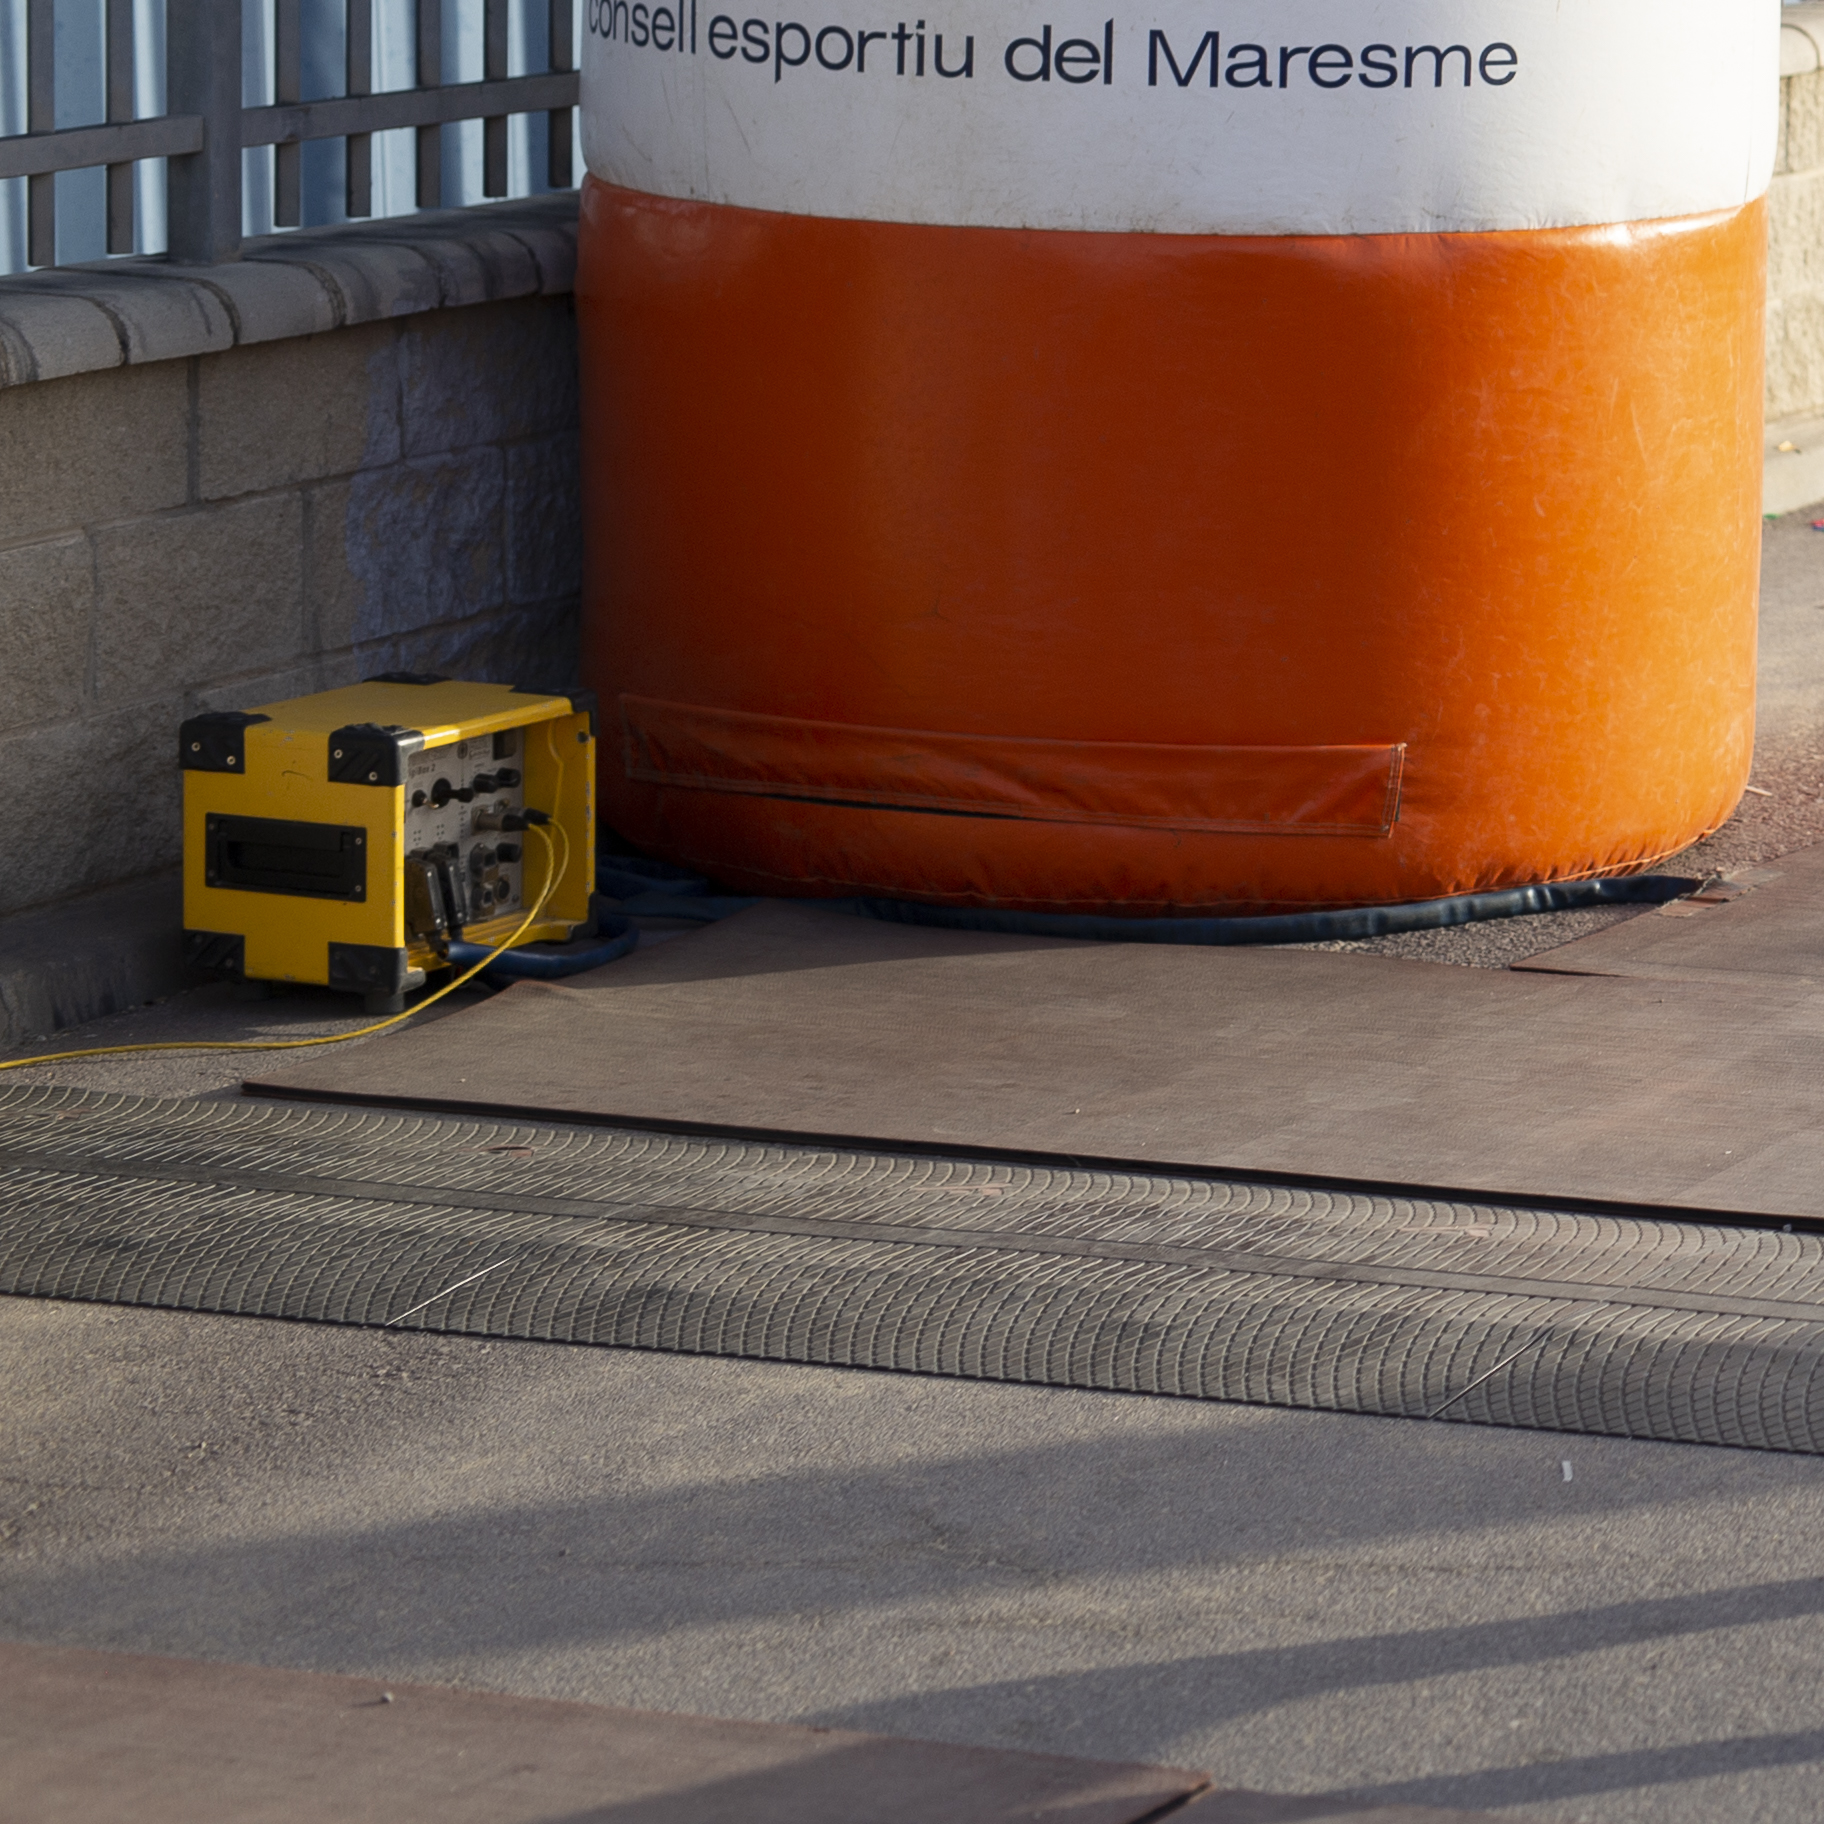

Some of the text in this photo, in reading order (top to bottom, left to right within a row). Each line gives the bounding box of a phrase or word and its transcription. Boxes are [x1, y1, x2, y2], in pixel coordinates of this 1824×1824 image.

[708, 14, 976, 84] esportiu
[1004, 17, 1115, 87] del
[1147, 28, 1520, 89] Maresme
